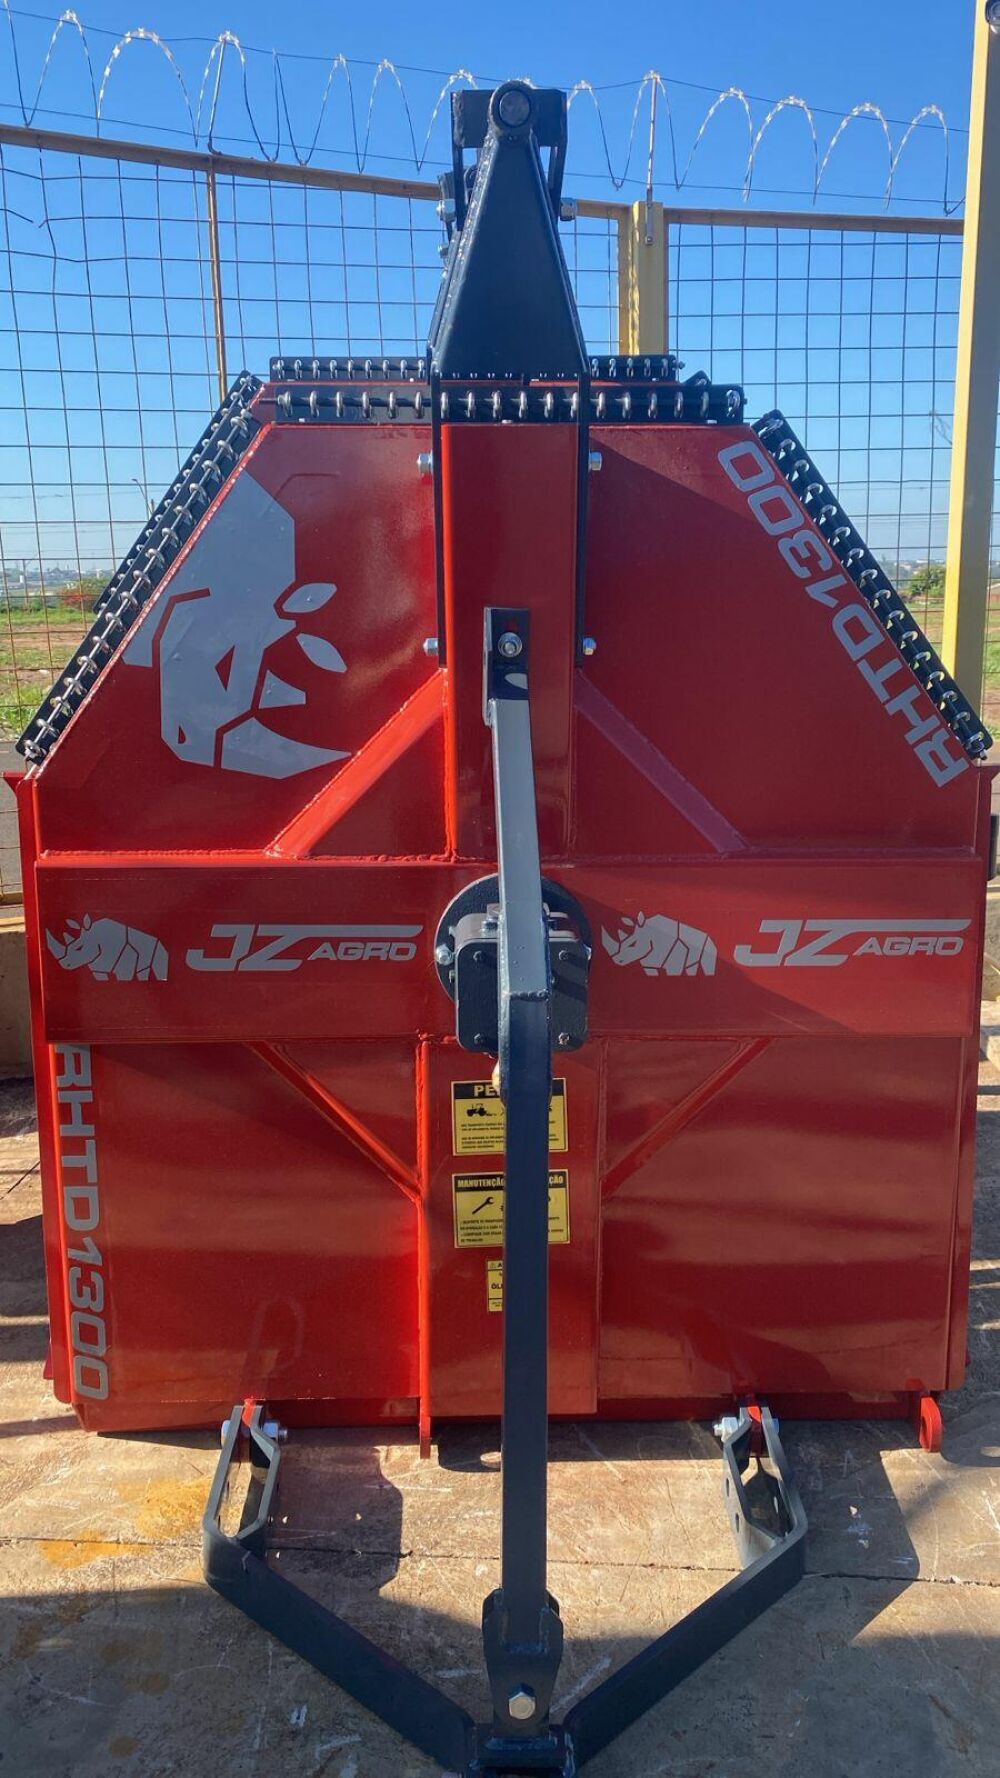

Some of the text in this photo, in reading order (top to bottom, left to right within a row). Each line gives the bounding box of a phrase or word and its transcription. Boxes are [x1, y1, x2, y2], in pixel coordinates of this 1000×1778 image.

[717, 441, 969, 787] RHTD1300
[308, 942, 416, 961] AGRO
[853, 937, 964, 956] AGRO
[54, 1044, 109, 1399] RHTD1300
